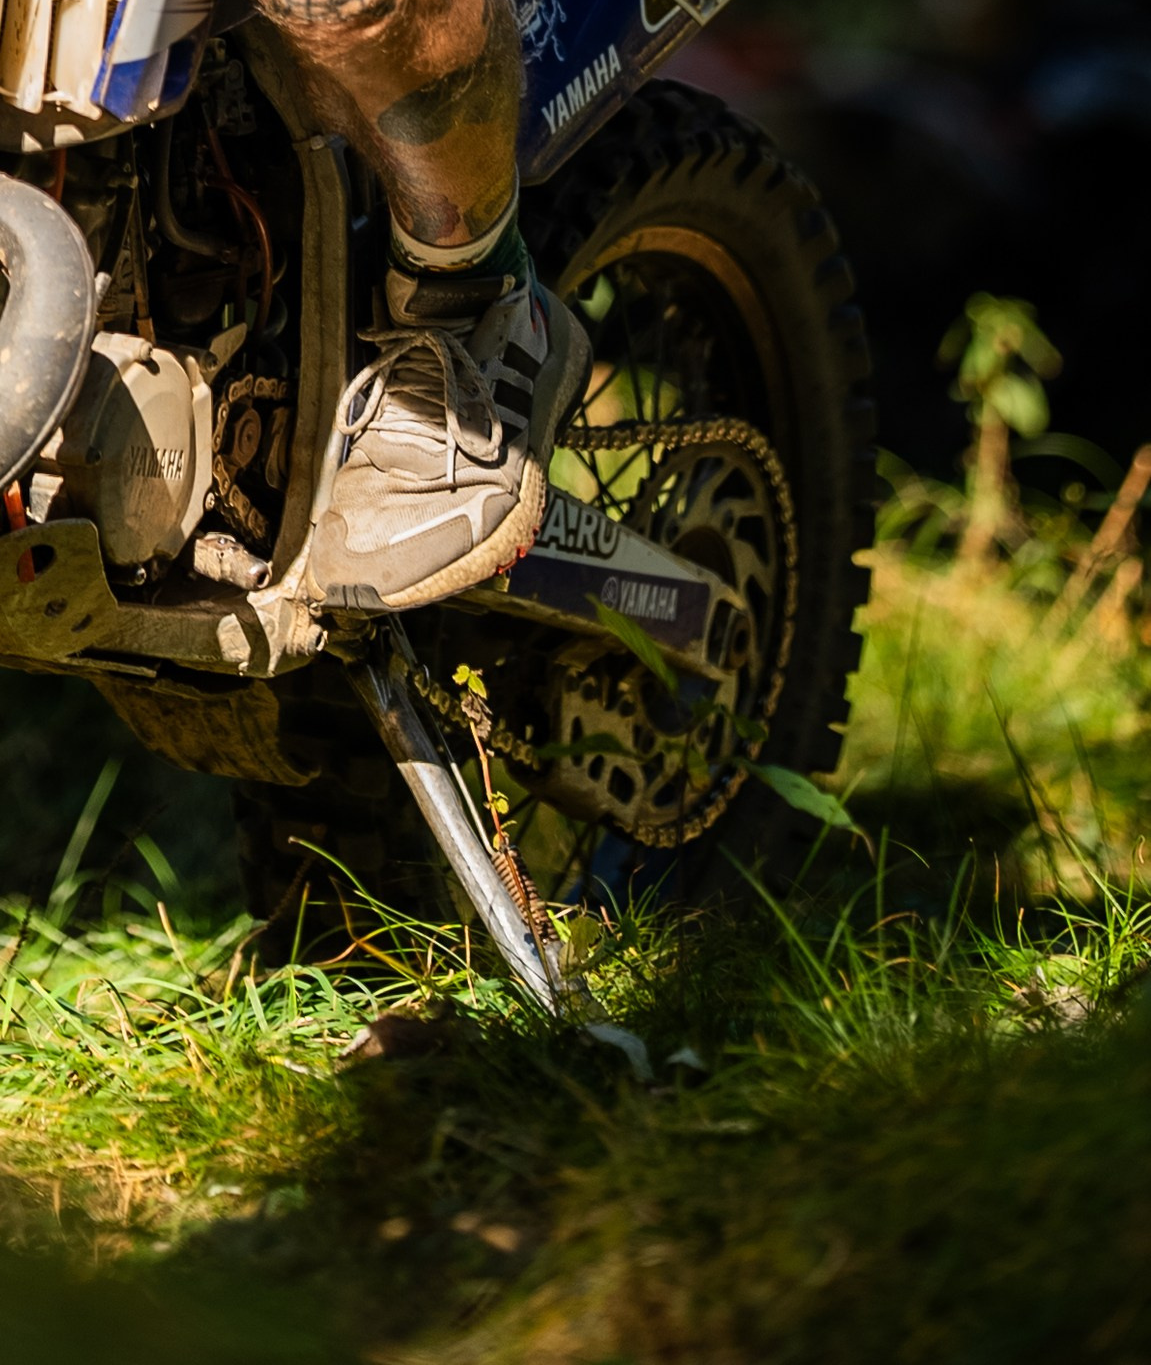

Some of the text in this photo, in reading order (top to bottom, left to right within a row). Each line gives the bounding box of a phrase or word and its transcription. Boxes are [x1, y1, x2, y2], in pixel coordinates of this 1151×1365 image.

[541, 43, 621, 135] YAMAHA
[131, 445, 184, 480] YAMAHA
[619, 579, 678, 621] YAMAHA
